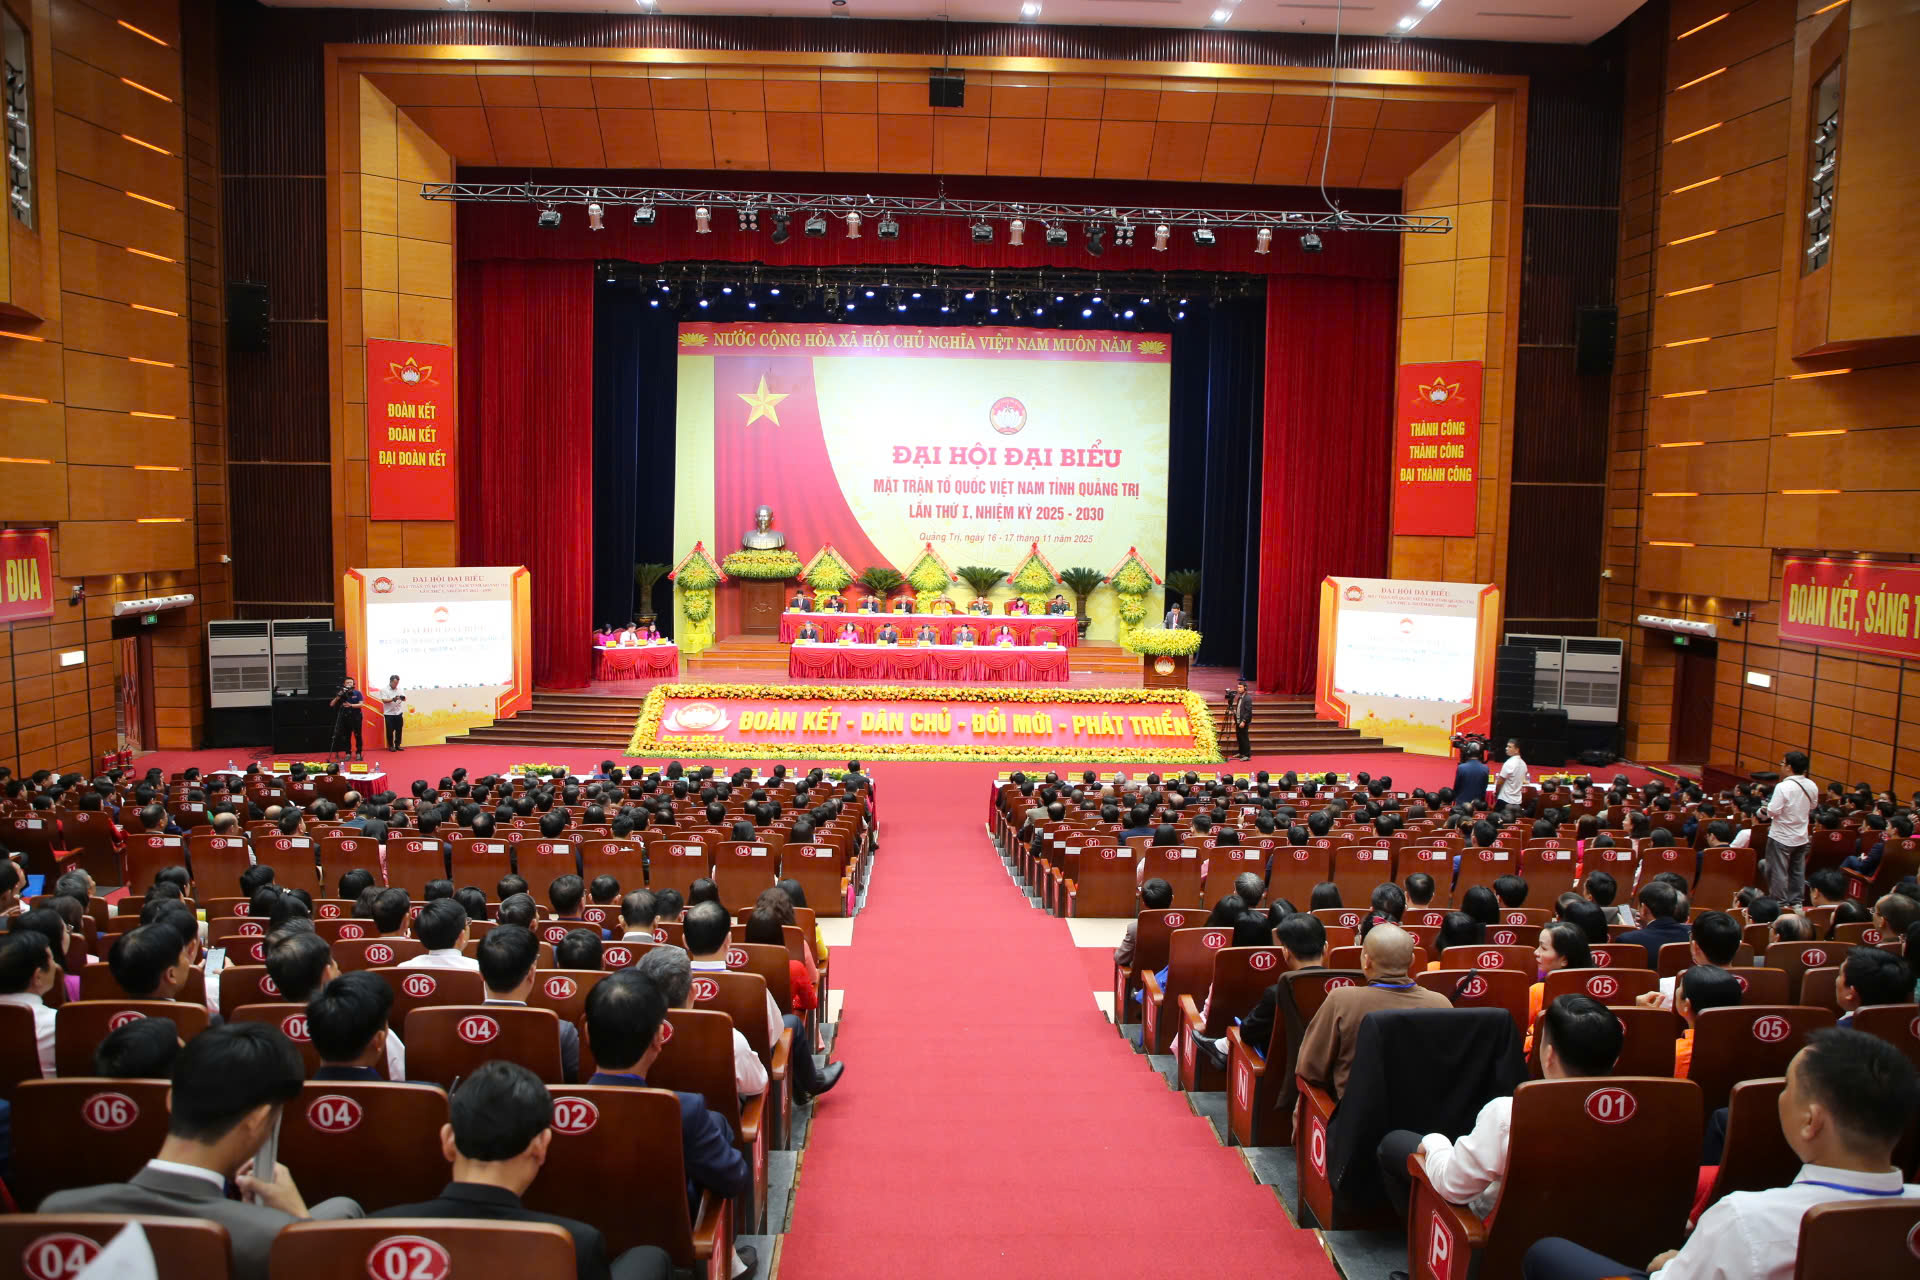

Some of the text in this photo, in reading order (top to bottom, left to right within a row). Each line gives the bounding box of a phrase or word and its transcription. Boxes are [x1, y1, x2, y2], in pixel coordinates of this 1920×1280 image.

[714, 329, 1132, 353] NƯỚC CỘNG HÒA XÃ HỘI CHỦ NGHĨA VIỆT NAM MUÔN NĂM
[388, 400, 436, 420] ĐOÀN KẾT
[388, 424, 437, 443] ĐOÀN KẾT
[1410, 418, 1465, 437] THÀNH CÔNG
[893, 438, 1122, 471] ĐẠI HỘI ĐẠI BIỂU
[1409, 441, 1464, 459] THÀNH CÔNG
[379, 448, 446, 468] ĐẠI ĐOÀN KẾT
[1400, 464, 1472, 485] ĐẠI THÀNH CÔNG
[873, 474, 1139, 500] MẶT TRẬN TỔ QUỐC VIỆT NAM TỈNH QUẢNG TRỊ
[909, 501, 932, 519] LẦN
[936, 502, 959, 519] THỨ
[976, 502, 1014, 522] NHIỆM
[1017, 502, 1033, 520] KỲ
[1036, 507, 1064, 520] 2025
[1076, 507, 1104, 521] 2030
[919, 532, 947, 544] Quảng
[964, 534, 985, 544] ngày
[987, 534, 997, 542] 16
[1005, 534, 1014, 542] 17
[1016, 533, 1040, 544] tháng
[1043, 534, 1052, 543] 11
[1054, 534, 1072, 543] năm
[1074, 535, 1093, 544] 2025
[6, 558, 42, 603] ĐUA
[1787, 574, 1909, 639] ĐOÀN KẾT, SÁNG
[739, 707, 797, 732] ĐOÀN
[802, 705, 842, 731] KẾT
[861, 708, 904, 732] DÂN
[910, 706, 951, 732] CHỦ
[971, 706, 1006, 733] ĐỔI
[1013, 710, 1053, 734] MỚI
[1072, 711, 1124, 735] PHÁT
[1129, 709, 1191, 736] TRIỂN
[151, 838, 161, 846] 22
[215, 840, 224, 848] 20
[410, 843, 419, 851] 14
[474, 844, 484, 852] 12
[539, 845, 549, 853] 10
[672, 847, 682, 855] 06
[738, 847, 748, 855] 04
[803, 848, 813, 856] 02
[1103, 850, 1113, 858] 01
[1168, 851, 1178, 859] 03
[1231, 851, 1241, 859] 05
[1295, 851, 1305, 859] 07
[1359, 851, 1369, 859] 09
[323, 907, 337, 917] 12
[588, 910, 602, 922] 06
[1168, 915, 1181, 925] 01
[1343, 915, 1356, 926] 05
[1426, 915, 1439, 925] 07
[1510, 915, 1523, 925] 09
[243, 924, 258, 936] 12
[343, 927, 361, 938] 10
[549, 930, 565, 941] 06
[1867, 931, 1880, 942] 15
[1208, 935, 1222, 946] 01
[1498, 933, 1512, 944] 07
[370, 947, 388, 961] 08
[609, 949, 626, 963] 04
[726, 951, 743, 965] 02
[1255, 954, 1272, 968] 01
[1482, 954, 1498, 967] 05
[1807, 951, 1820, 963] 11
[409, 977, 430, 993] 06
[550, 979, 571, 996] 04
[1593, 979, 1612, 995] 05
[465, 1020, 491, 1039] 04
[1759, 1020, 1783, 1038] 05
[94, 1100, 128, 1124] 06
[1597, 1095, 1625, 1118] 01
[318, 1103, 352, 1127] 04
[554, 1104, 588, 1128] 02
[1313, 1128, 1324, 1167] O
[1431, 1223, 1448, 1267] P
[383, 1248, 433, 1280] 02
